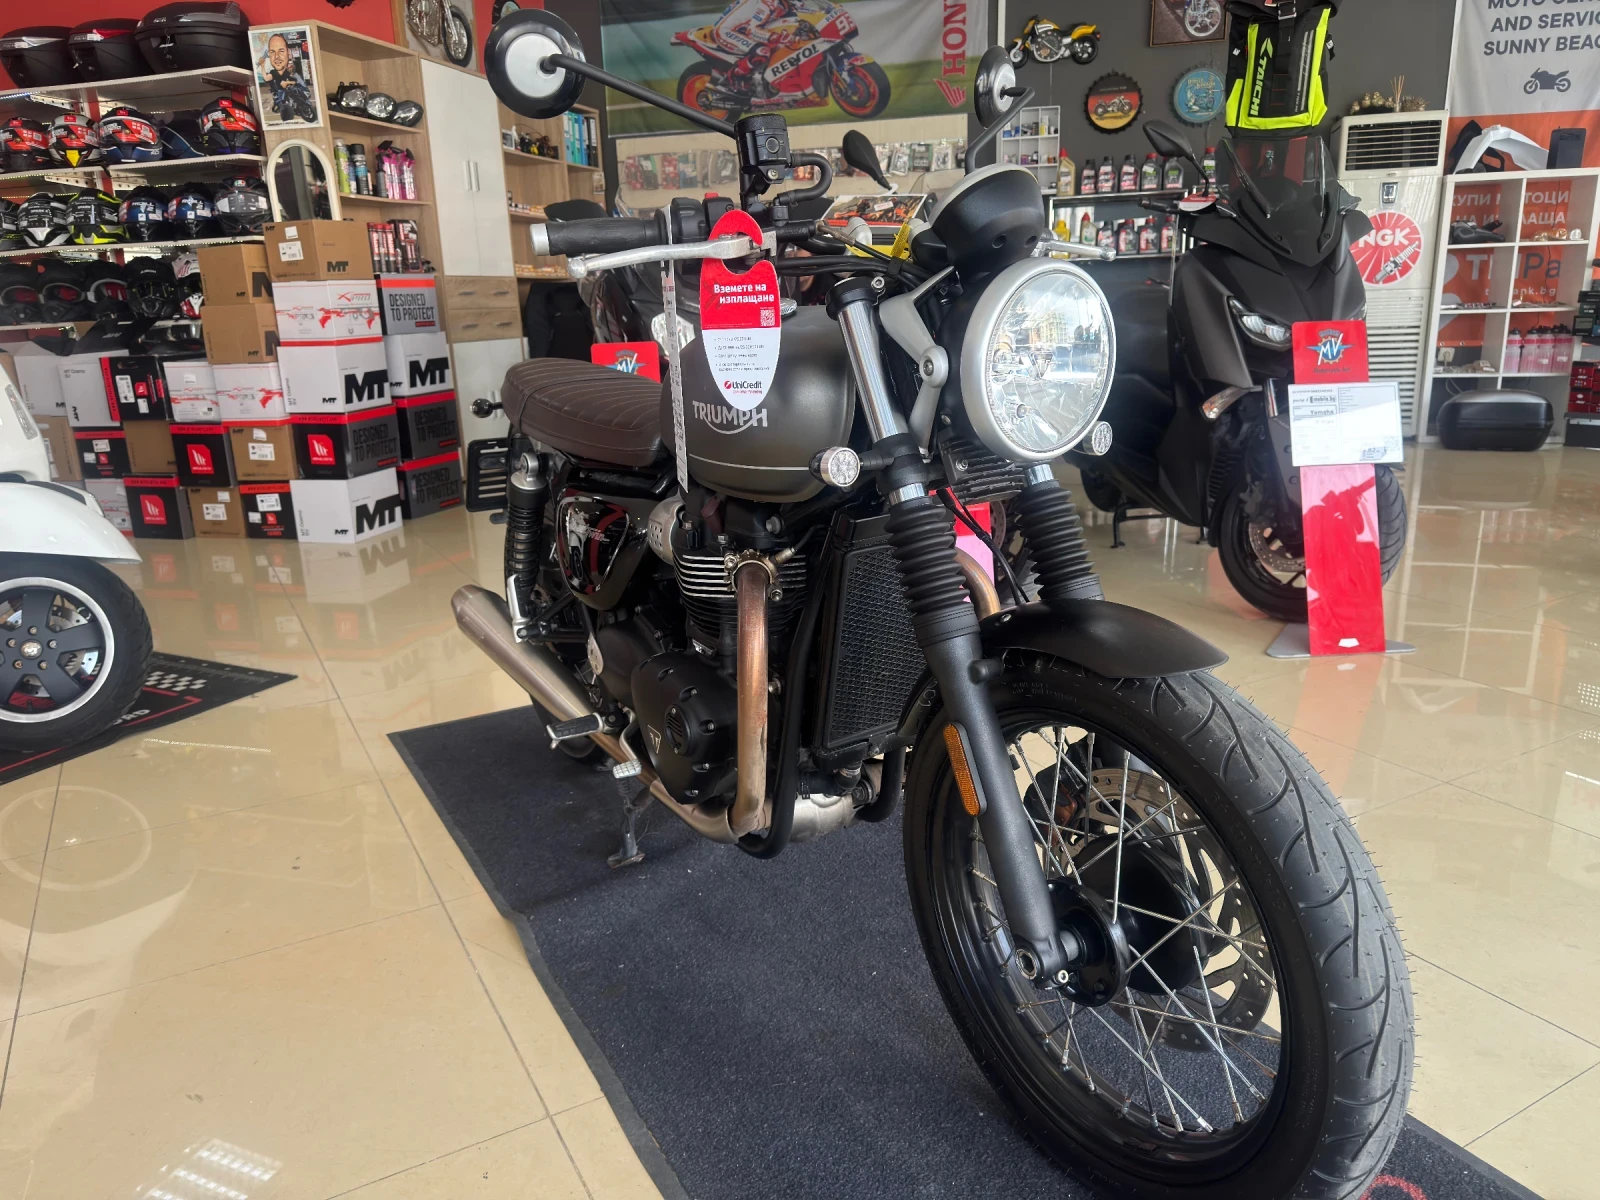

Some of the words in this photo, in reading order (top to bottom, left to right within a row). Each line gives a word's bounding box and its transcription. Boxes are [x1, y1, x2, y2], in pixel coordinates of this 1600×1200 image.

[1490, 15, 1533, 32] AND
[943, 0, 967, 76] HON
[1483, 37, 1551, 56] SUNNY
[1250, 56, 1267, 116] TAICHI
[1358, 228, 1411, 247] NGK
[326, 261, 348, 273] MT
[714, 283, 753, 294] Вземете
[755, 283, 767, 292] на
[389, 293, 426, 306] DESIGNED
[719, 294, 775, 304] изплащане
[391, 308, 401, 321] TO
[403, 306, 435, 321] PROTECT
[1317, 333, 1344, 365] MV
[409, 357, 450, 388] MT
[344, 369, 390, 405] MT
[732, 380, 762, 389] UniCredit
[692, 400, 769, 428] TRIUMPH
[352, 424, 389, 445] DESIGNED
[354, 447, 365, 462] TO
[365, 438, 397, 460] PROTECT
[412, 468, 450, 487] DESIGNED
[416, 488, 426, 503] TO
[426, 480, 459, 500] PROTECT
[356, 494, 402, 535] MT
